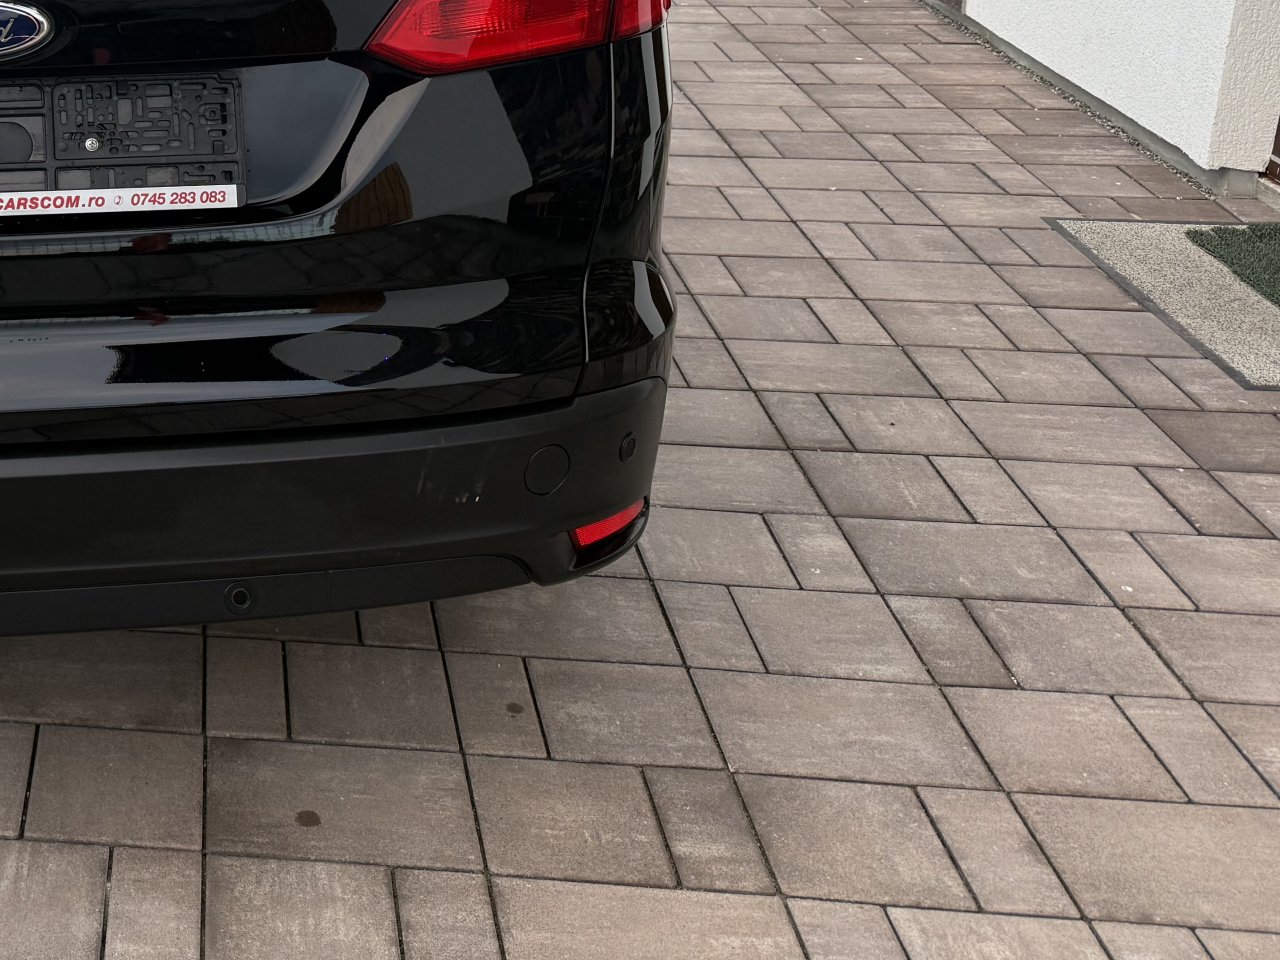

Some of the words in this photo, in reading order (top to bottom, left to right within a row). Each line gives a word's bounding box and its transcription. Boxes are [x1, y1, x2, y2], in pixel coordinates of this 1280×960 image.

[130, 192, 166, 206] 0745
[170, 191, 196, 205] 283
[199, 190, 227, 204] 083
